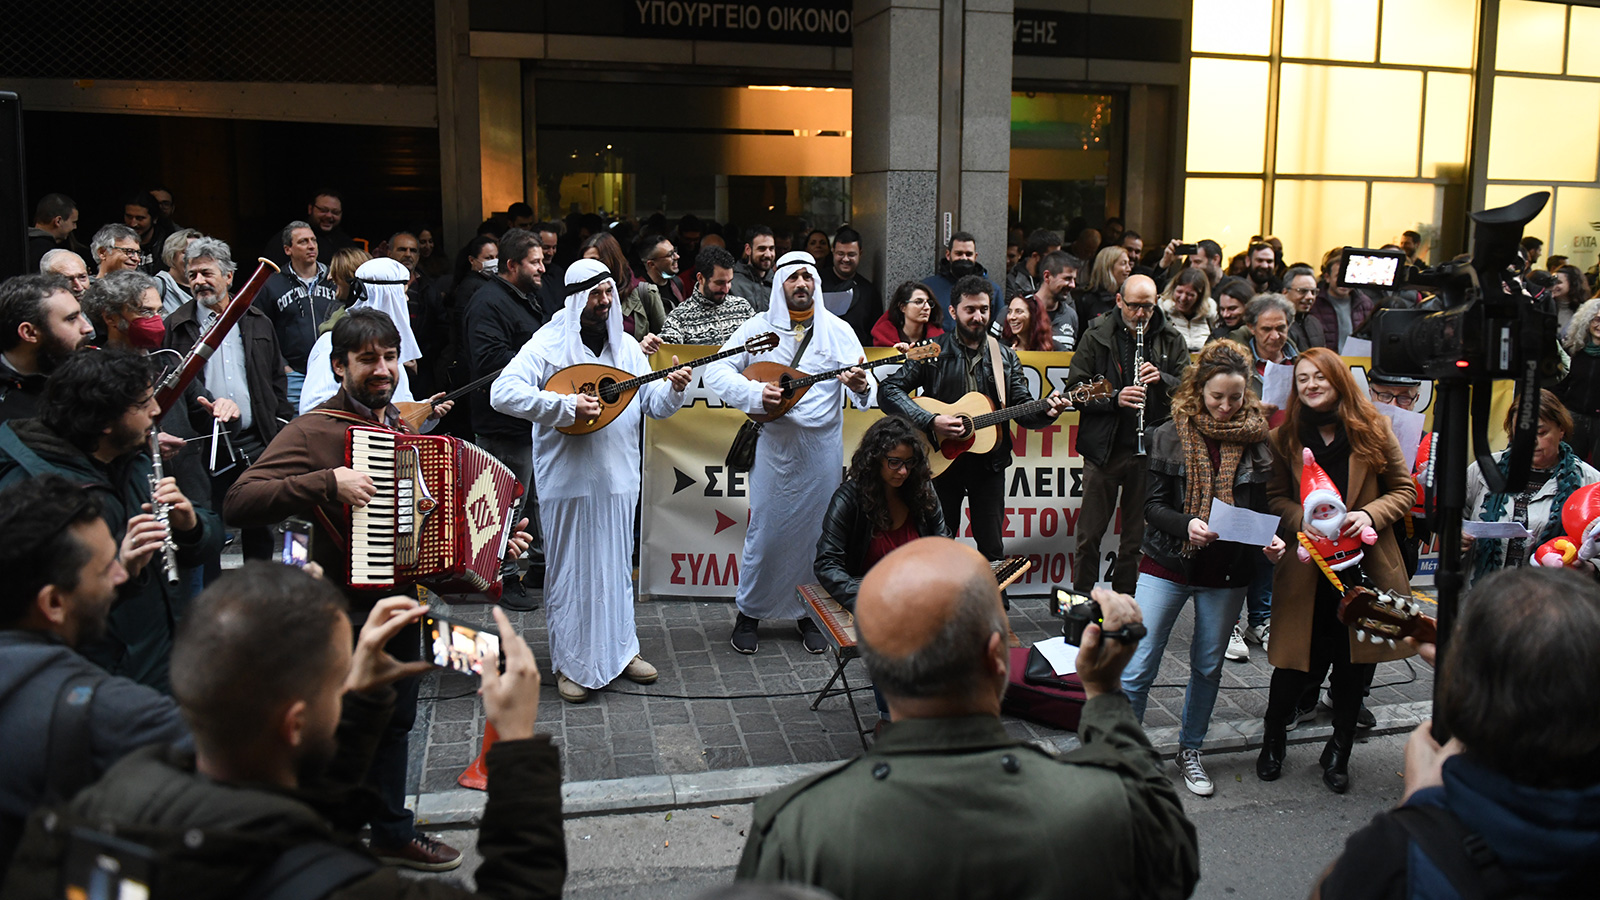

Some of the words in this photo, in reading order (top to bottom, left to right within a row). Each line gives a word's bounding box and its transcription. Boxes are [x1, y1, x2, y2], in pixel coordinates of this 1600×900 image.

[636, 0, 761, 30] ΥΠΟΥΡΓΕΙΟ
[767, 6, 854, 34] ΟΙΚΟΝΟ
[1519, 360, 1538, 430] Panasonic
